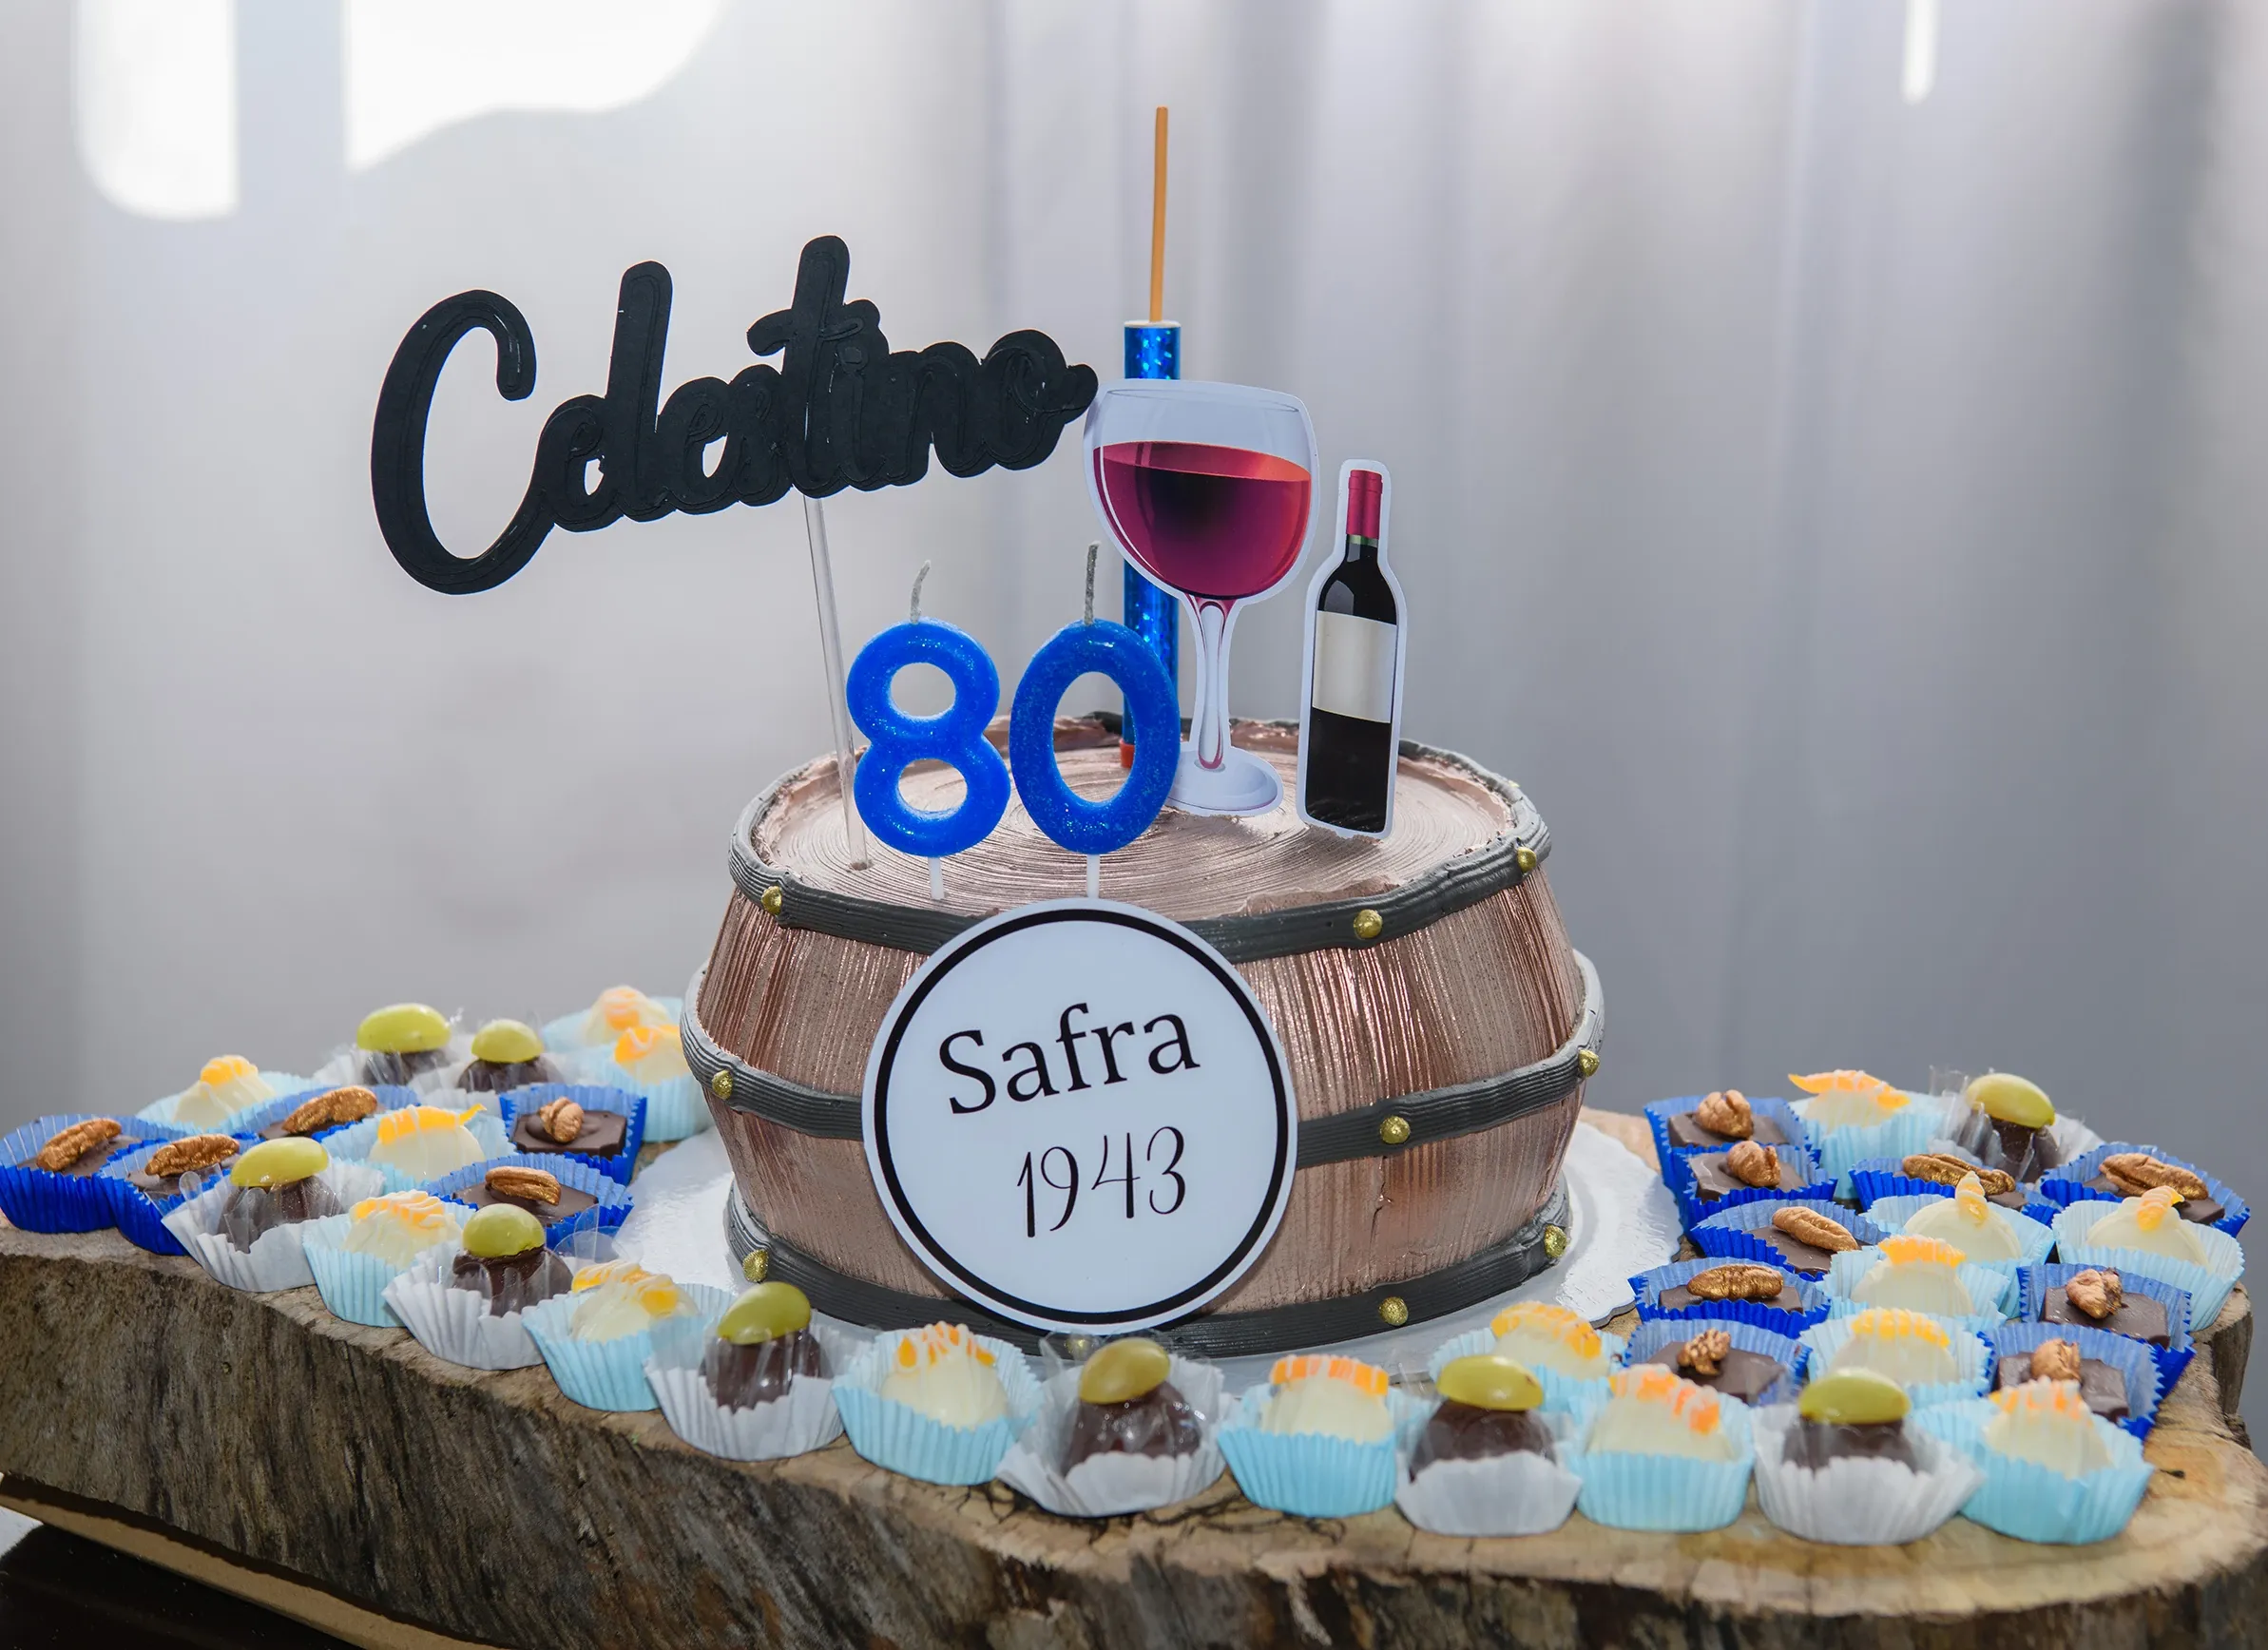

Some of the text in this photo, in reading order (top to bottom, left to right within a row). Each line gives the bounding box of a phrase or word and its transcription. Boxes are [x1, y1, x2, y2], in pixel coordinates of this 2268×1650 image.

[371, 235, 1099, 595] Celestino
[846, 617, 1181, 857] 80
[938, 1002, 1201, 1115] Safra
[1017, 1125, 1186, 1238] 1943
